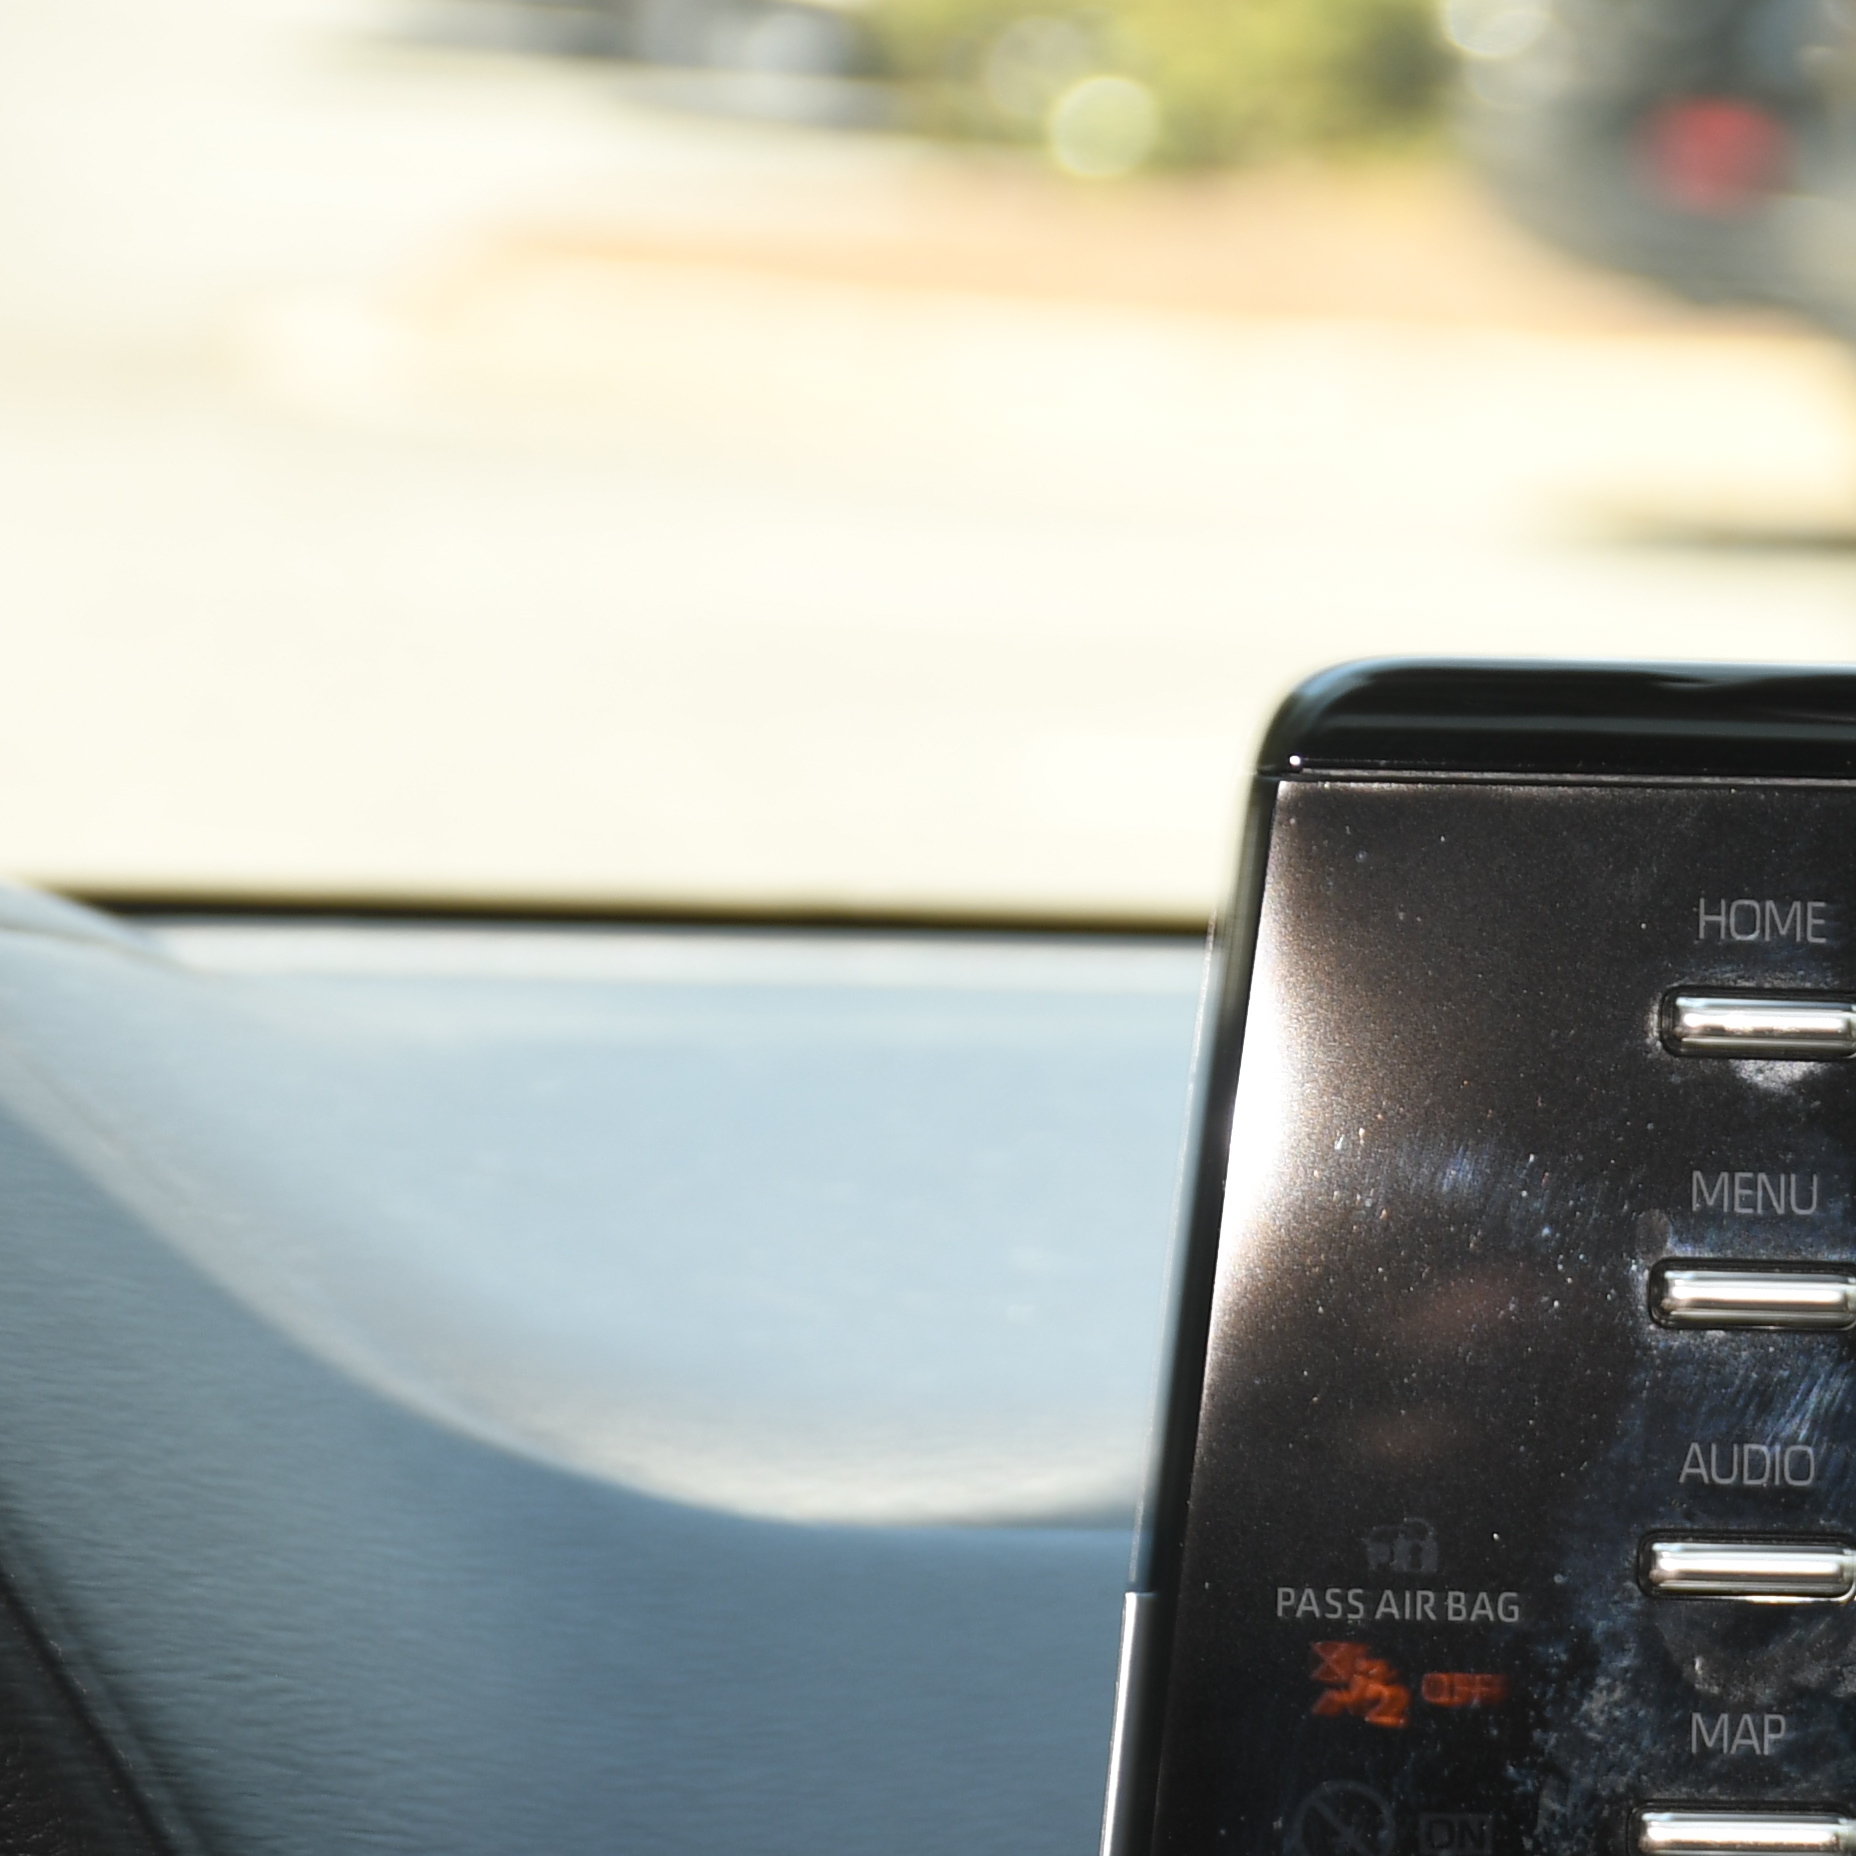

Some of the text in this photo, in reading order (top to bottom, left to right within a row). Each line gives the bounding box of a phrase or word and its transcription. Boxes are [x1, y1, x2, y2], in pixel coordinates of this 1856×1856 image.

[1698, 898, 1827, 944] HOME
[1691, 1170, 1819, 1216] MENU
[1679, 1442, 1817, 1487] AUDIO
[1276, 1586, 1520, 1623] PASS AIR BAG
[1690, 1712, 1789, 1757] MAP
